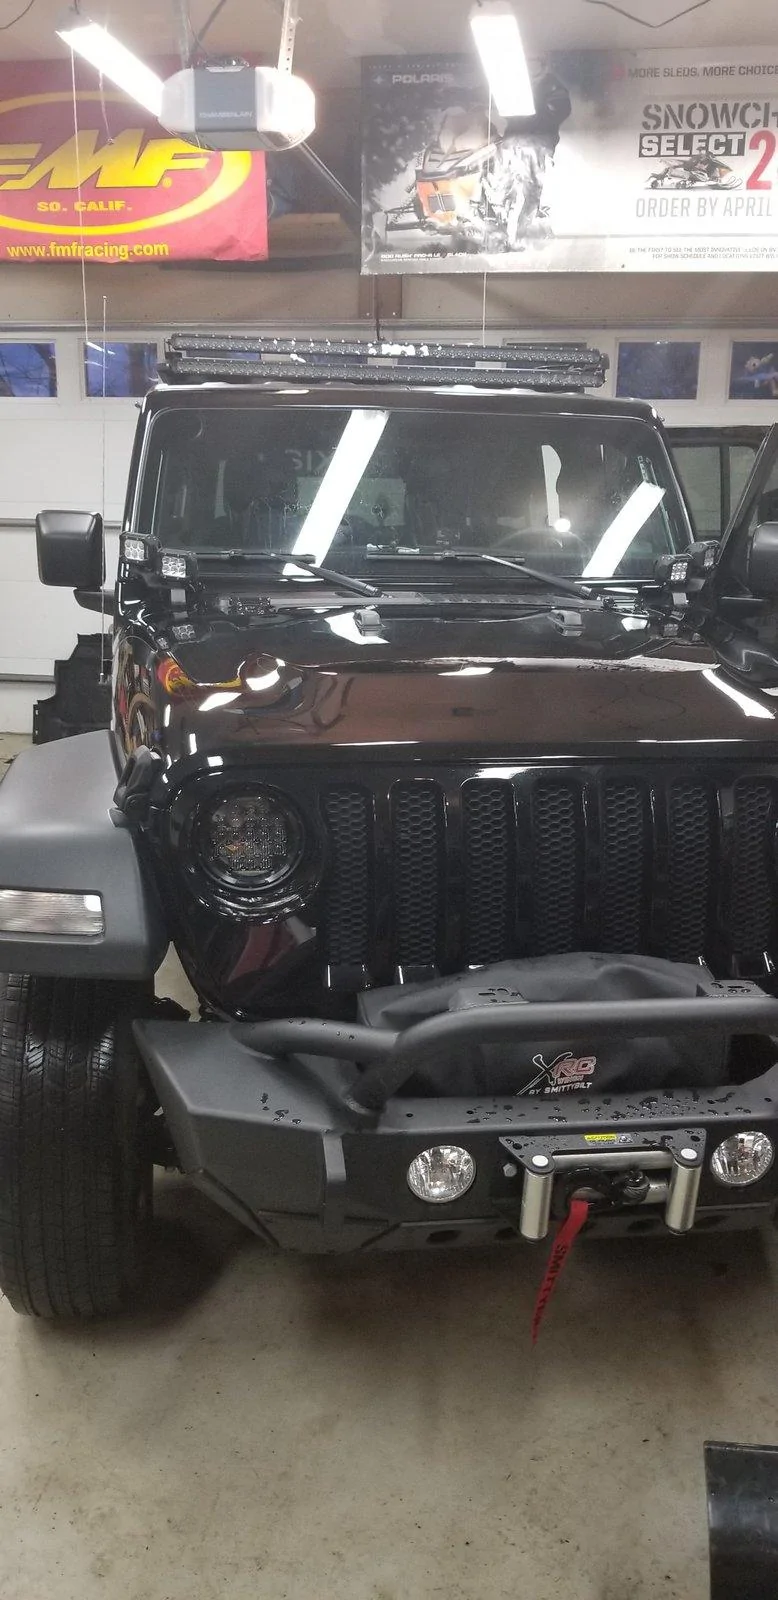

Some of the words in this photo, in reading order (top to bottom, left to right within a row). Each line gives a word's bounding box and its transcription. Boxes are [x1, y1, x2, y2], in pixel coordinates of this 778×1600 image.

[628, 67, 660, 78] MORE
[702, 65, 736, 77] MORE
[392, 73, 455, 84] POLARIS
[640, 133, 745, 157] SELECT
[37, 200, 68, 212] SO.
[74, 200, 133, 212] CALIF.
[636, 197, 691, 218] ORDER
[697, 197, 720, 218] BY
[723, 196, 773, 218] APRIL
[7, 241, 169, 260] www.fmfracing.com
[544, 1082, 592, 1094] SMITTYBILT
